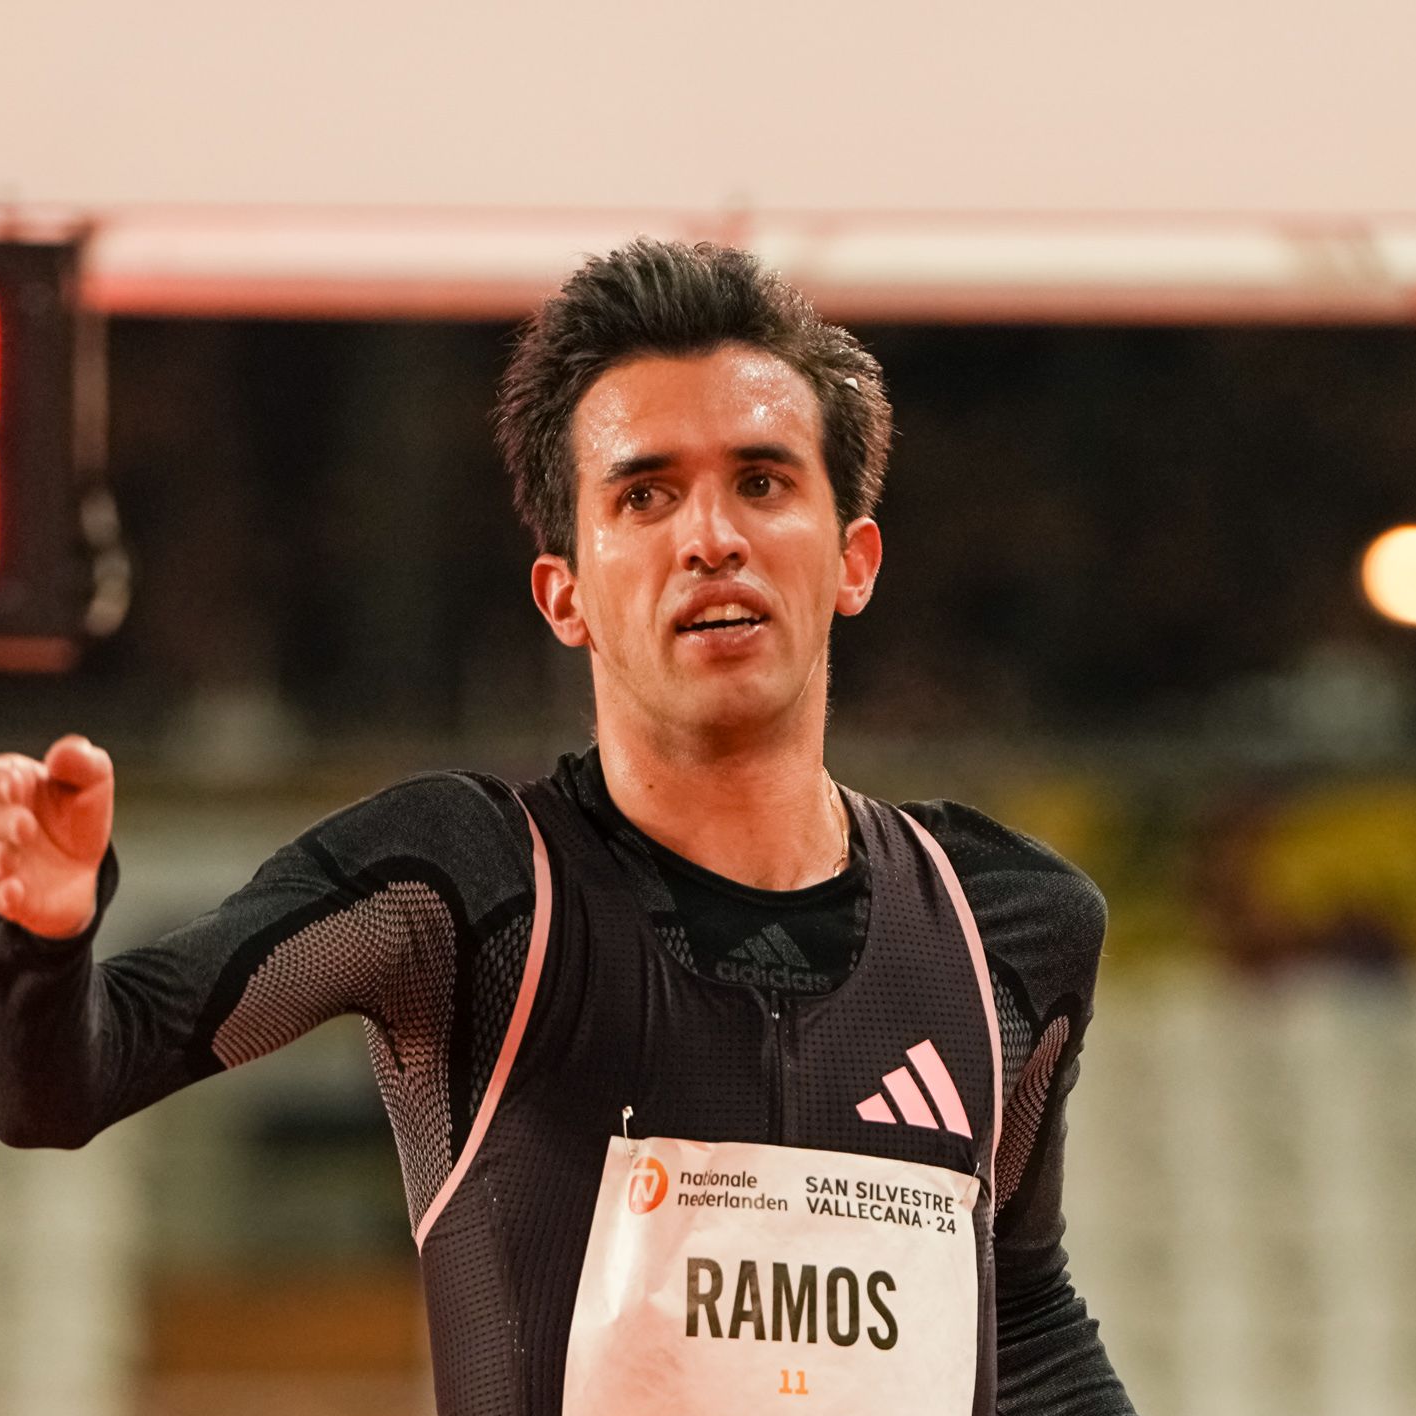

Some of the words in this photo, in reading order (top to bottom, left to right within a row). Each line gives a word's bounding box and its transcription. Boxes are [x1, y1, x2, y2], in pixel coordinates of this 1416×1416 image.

[715, 961, 832, 992] adidas
[680, 1169, 758, 1189] nationale
[677, 1190, 788, 1211] nederlanden
[805, 1176, 848, 1197] SAN
[855, 1181, 955, 1214] SILVESTRE
[805, 1196, 923, 1228] VALLECANA
[935, 1216, 957, 1235] 24
[685, 1257, 899, 1351] RAMOS
[778, 1369, 809, 1395] 11
